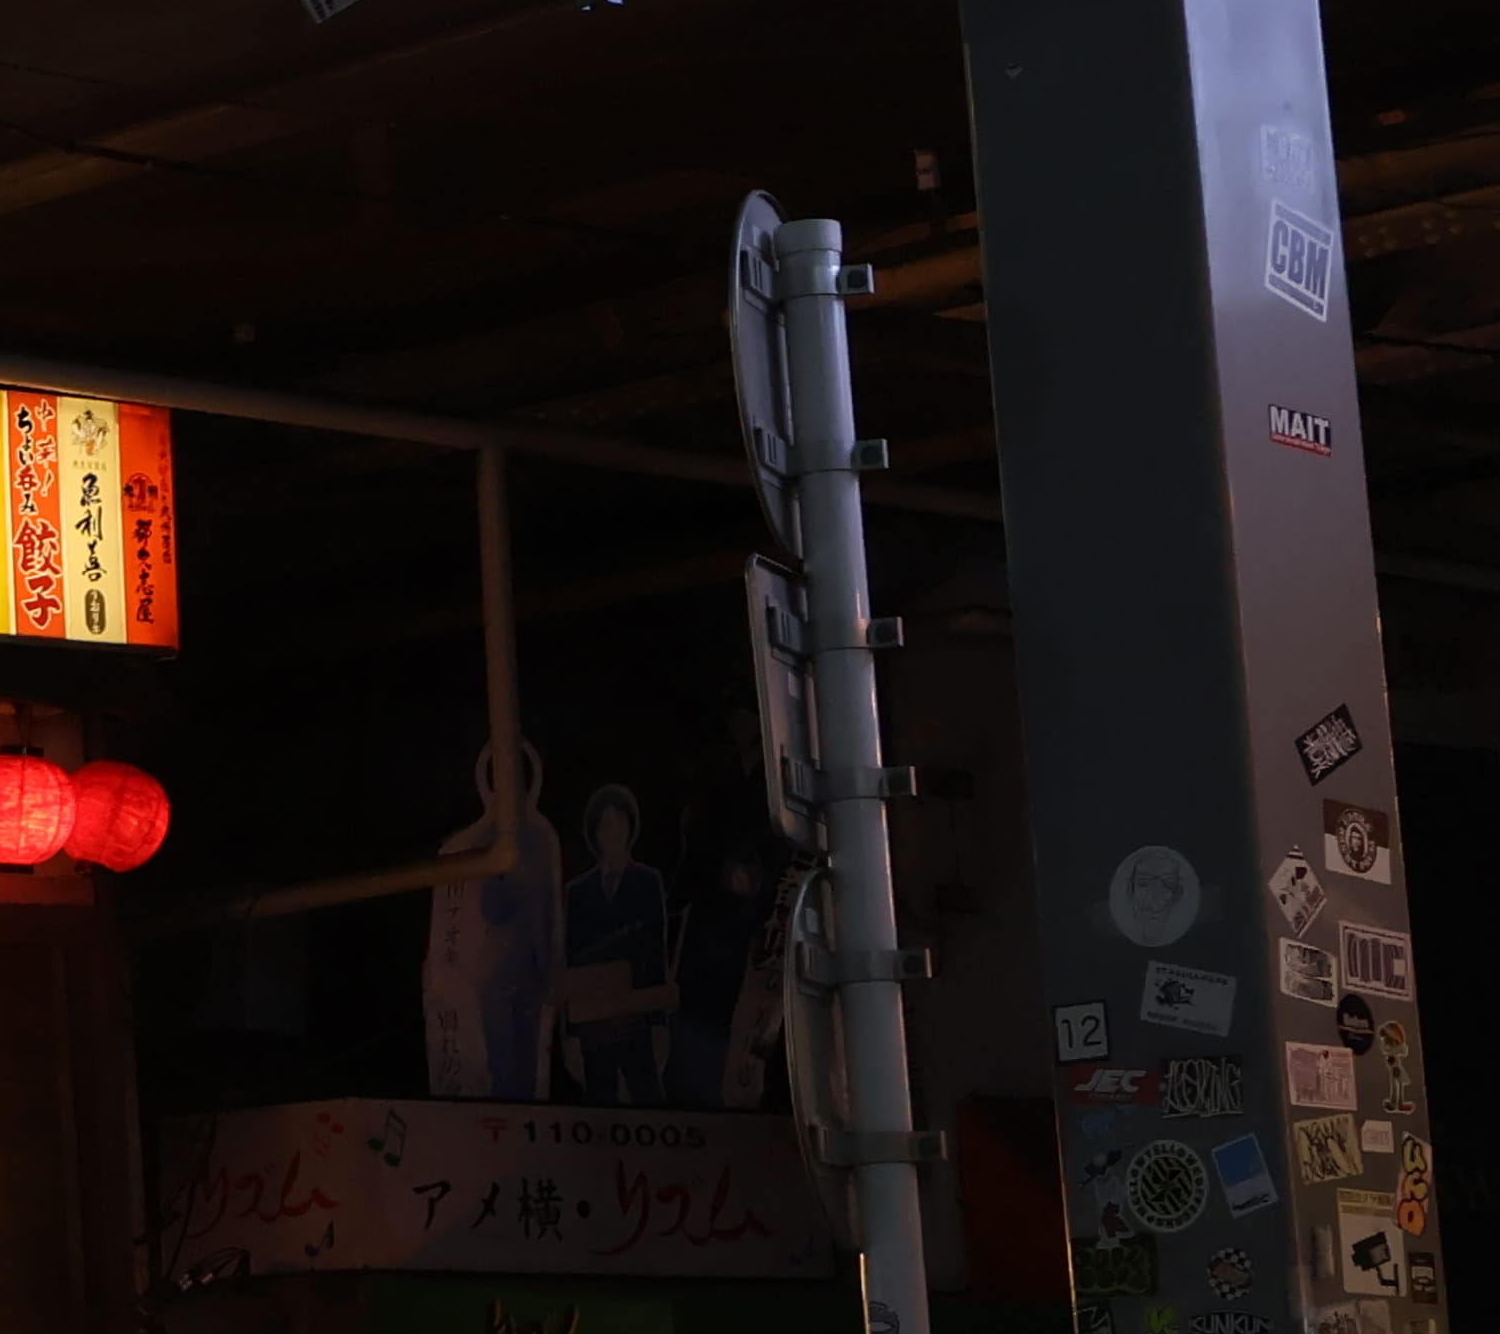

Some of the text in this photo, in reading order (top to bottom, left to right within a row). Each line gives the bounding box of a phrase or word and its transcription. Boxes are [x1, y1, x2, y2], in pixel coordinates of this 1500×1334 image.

[1270, 219, 1332, 300] CBM
[14, 403, 41, 516] ちょい呑み
[1269, 405, 1331, 447] MAIT
[75, 472, 108, 583] 魚利喜
[13, 517, 63, 630] 餃子
[1060, 1015, 1102, 1051] 12
[522, 1119, 708, 1148] 110-0005
